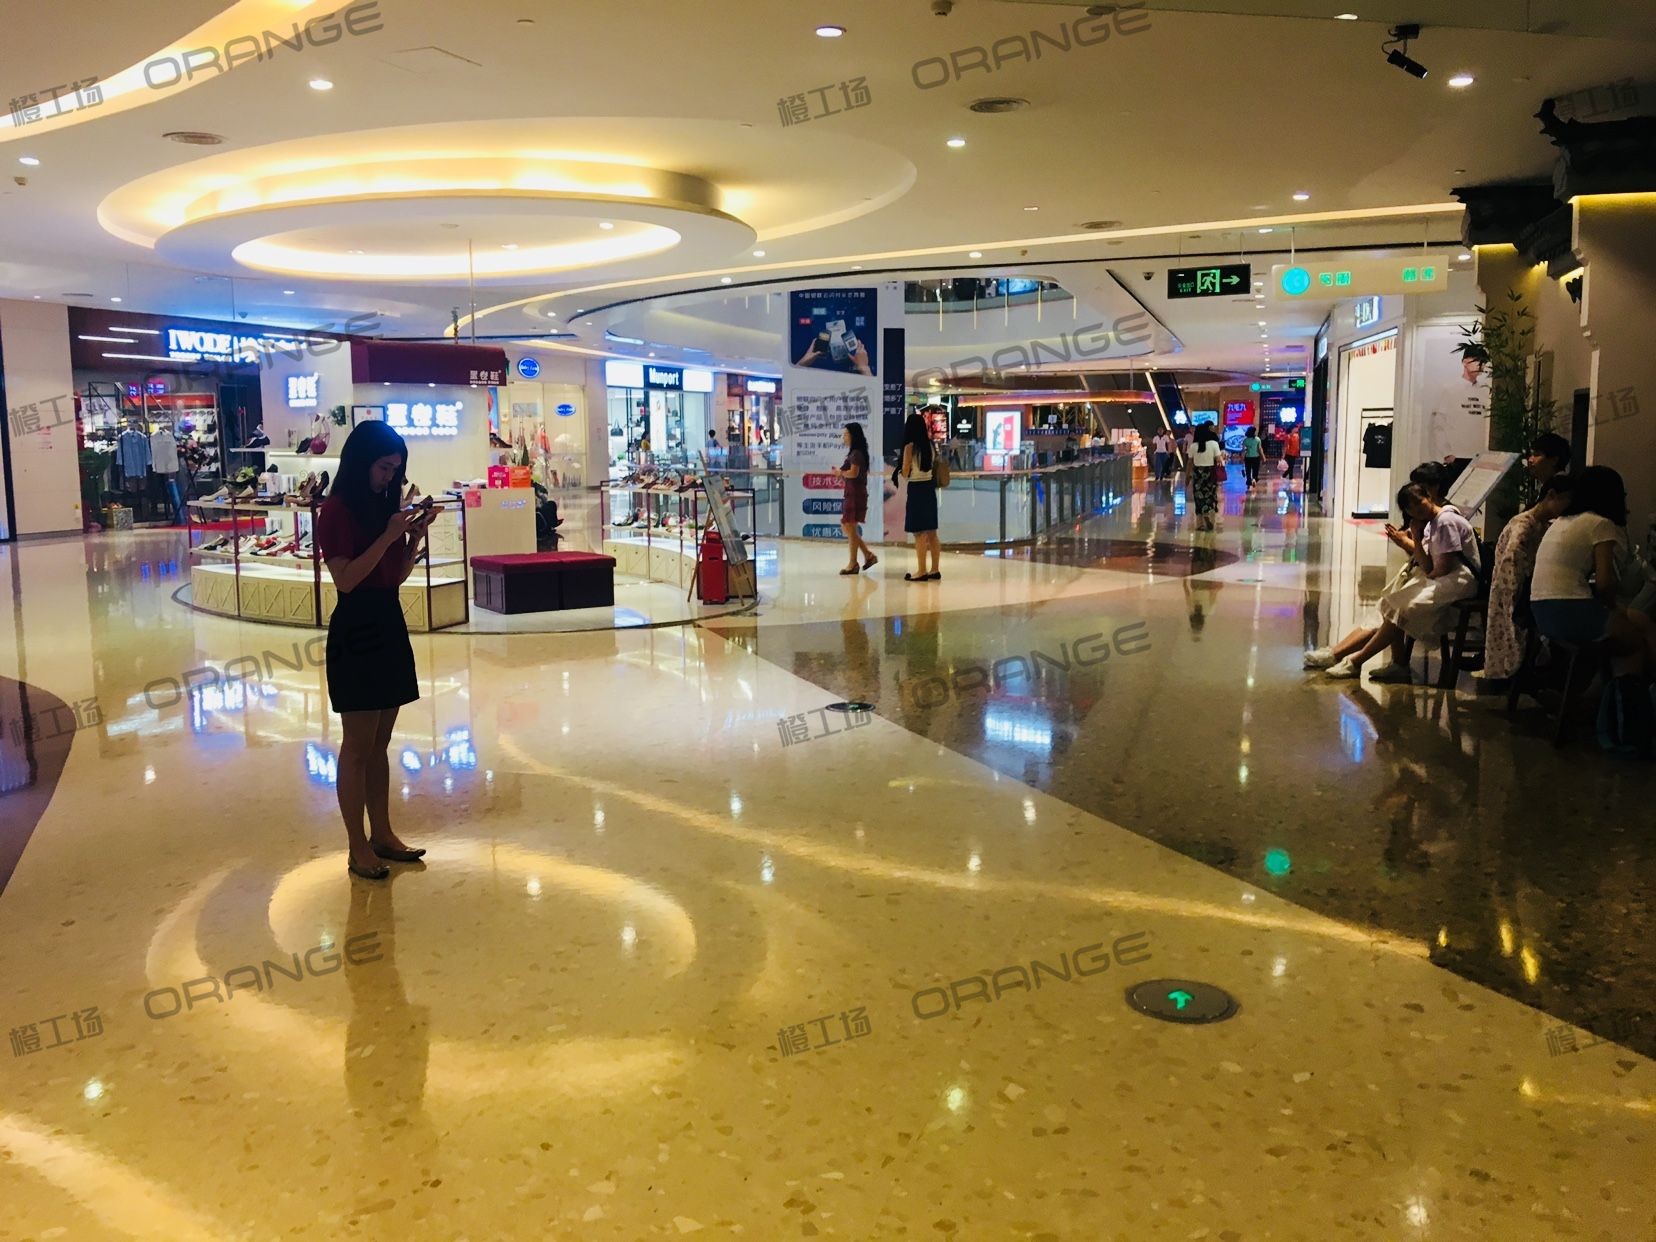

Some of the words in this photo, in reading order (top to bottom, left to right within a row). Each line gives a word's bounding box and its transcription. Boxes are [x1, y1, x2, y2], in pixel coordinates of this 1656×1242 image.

[168, 329, 232, 354] IWODE
[812, 476, 843, 487] 技术安
[812, 501, 843, 512] 风险保
[812, 527, 843, 537] 优惠不
